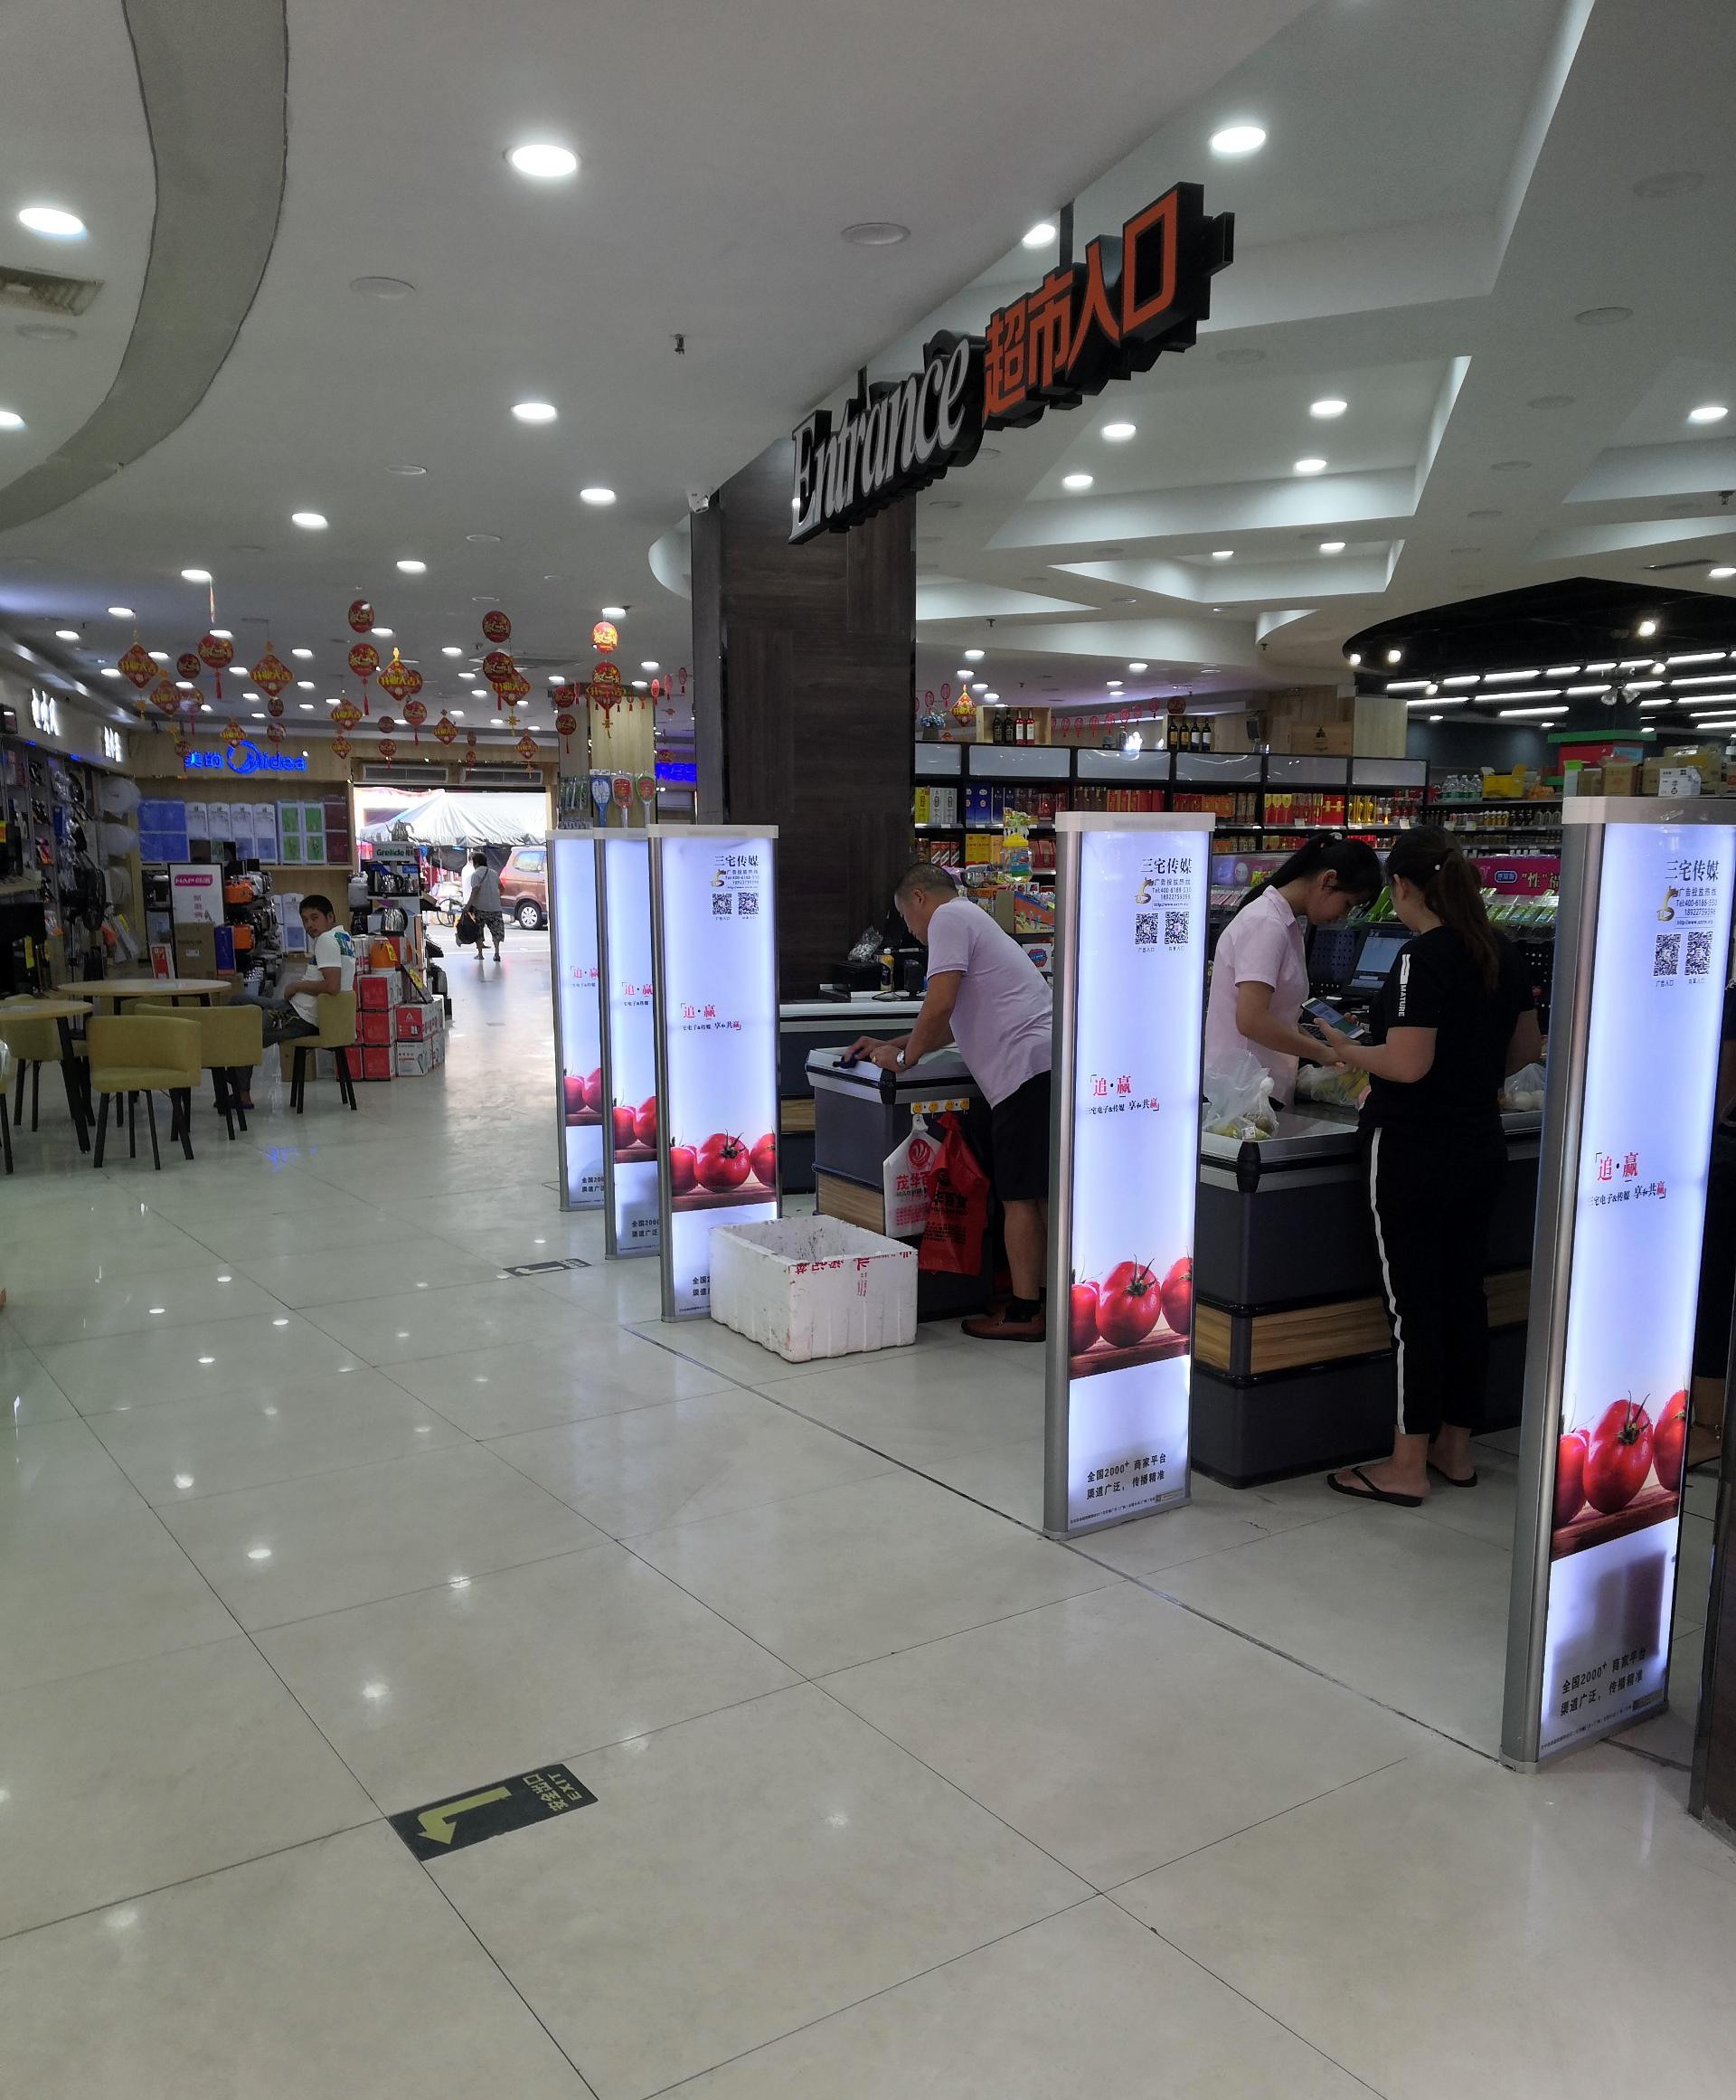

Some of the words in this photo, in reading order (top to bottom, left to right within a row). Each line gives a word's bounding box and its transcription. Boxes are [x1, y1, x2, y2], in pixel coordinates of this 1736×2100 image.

[983, 189, 1178, 420] 超市入口
[789, 338, 971, 544] Entrance
[184, 752, 223, 770] 美的
[237, 750, 306, 771] Midea
[714, 855, 760, 867] 三宅传媒
[1140, 857, 1193, 875] 三宅传媒
[1665, 859, 1720, 882] 三宅传媒
[1398, 984, 1407, 1017] MATURE
[1134, 1452, 1166, 1471] 商家平台
[1132, 1470, 1165, 1488] 传播精准
[1611, 1648, 1646, 1673] 商家平台
[1609, 1669, 1643, 1696] 传播精准
[523, 1773, 569, 1811] 安全出口
[548, 1773, 582, 1802] EXIT
